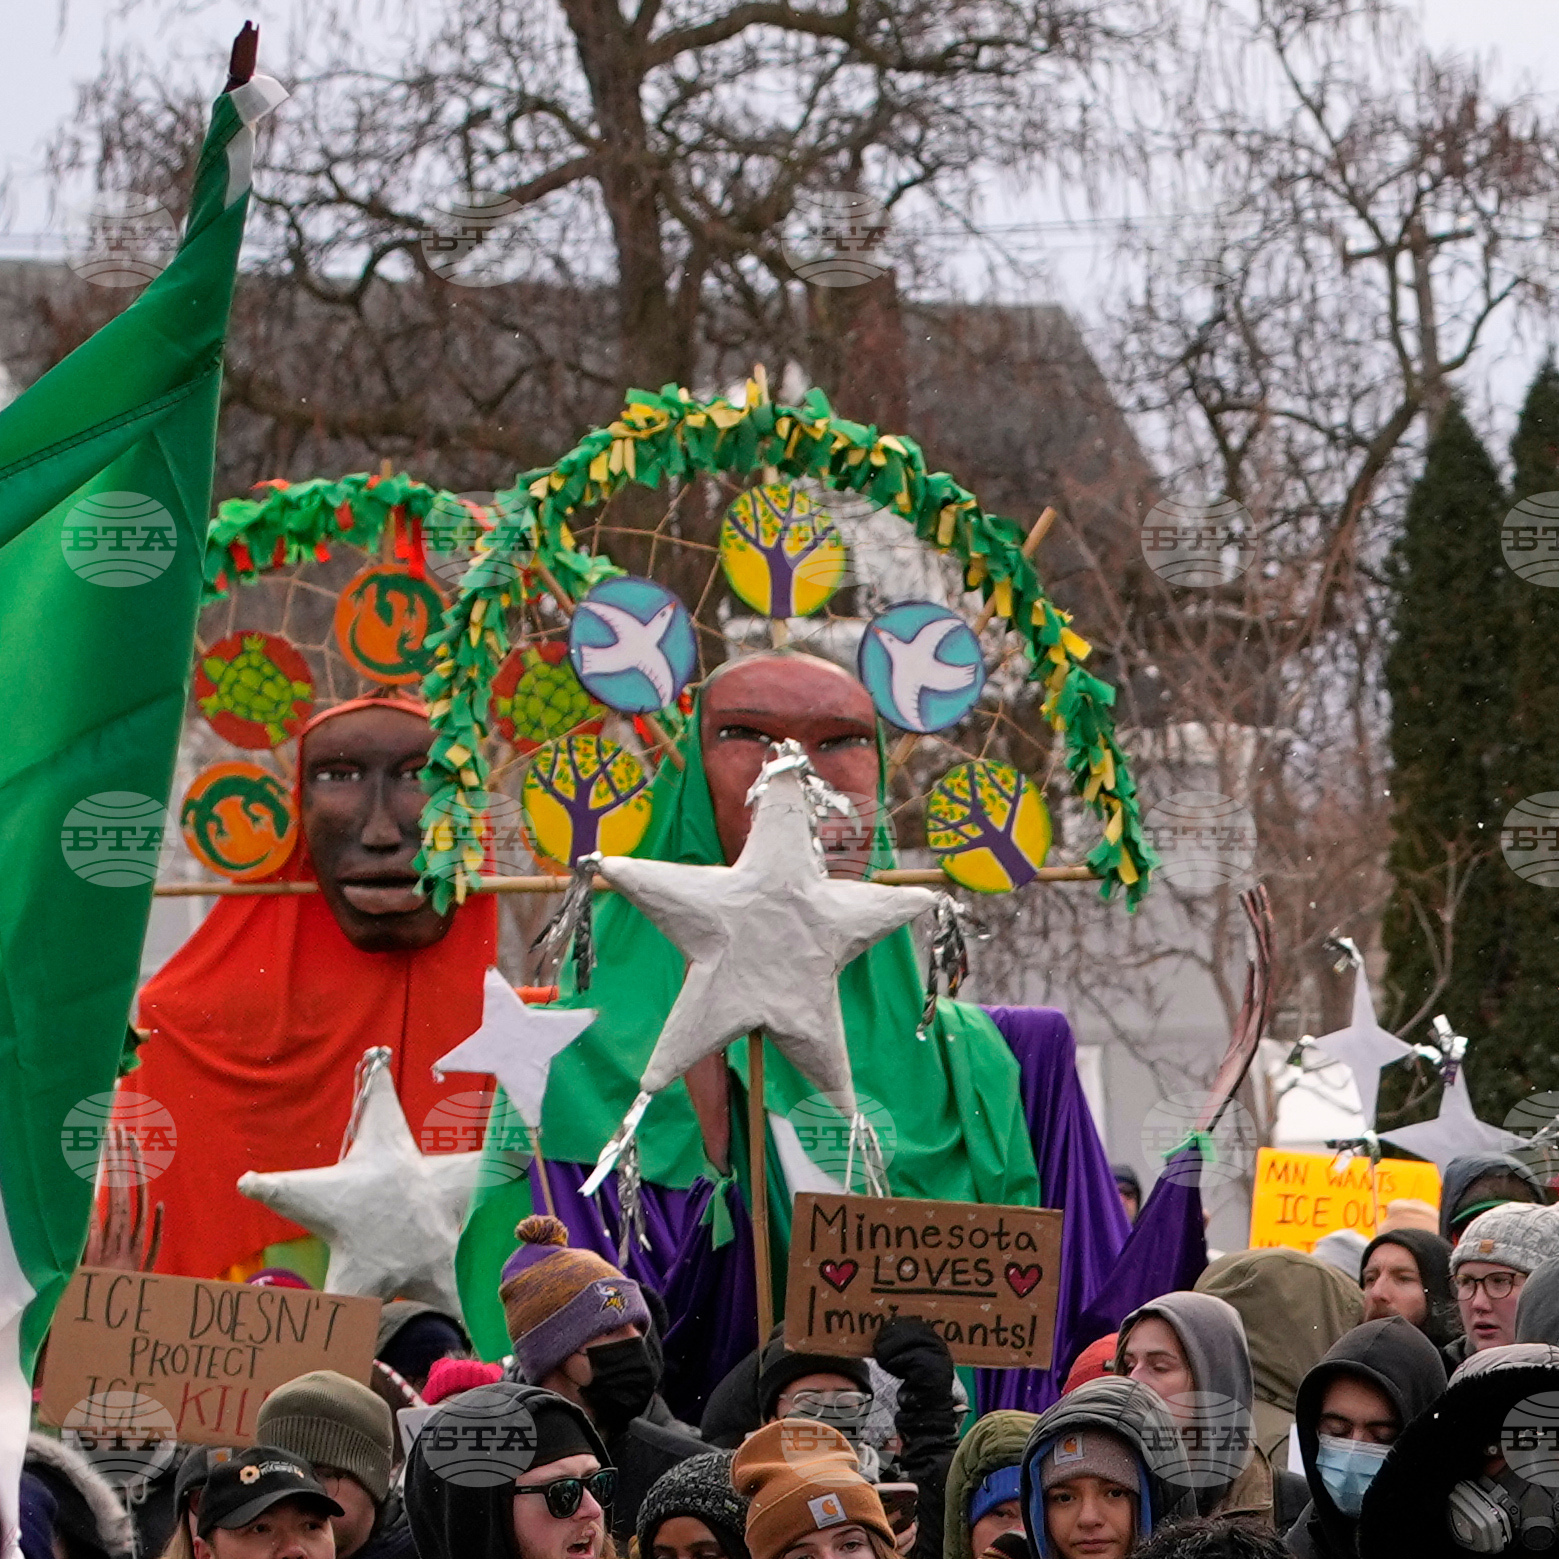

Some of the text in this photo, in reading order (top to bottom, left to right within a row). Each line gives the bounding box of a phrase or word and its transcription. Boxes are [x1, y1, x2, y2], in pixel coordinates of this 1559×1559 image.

[1265, 1159, 1398, 1194] MN WANTS
[810, 1203, 1038, 1255] Minnesota
[1275, 1193, 1332, 1228] ICE
[874, 1255, 996, 1288] LOVES
[74, 1271, 347, 1352] ICE DOESN'T
[808, 1285, 1038, 1358] Immrants!
[129, 1336, 264, 1380] PROTECT
[77, 1375, 260, 1438] ICE KIL
